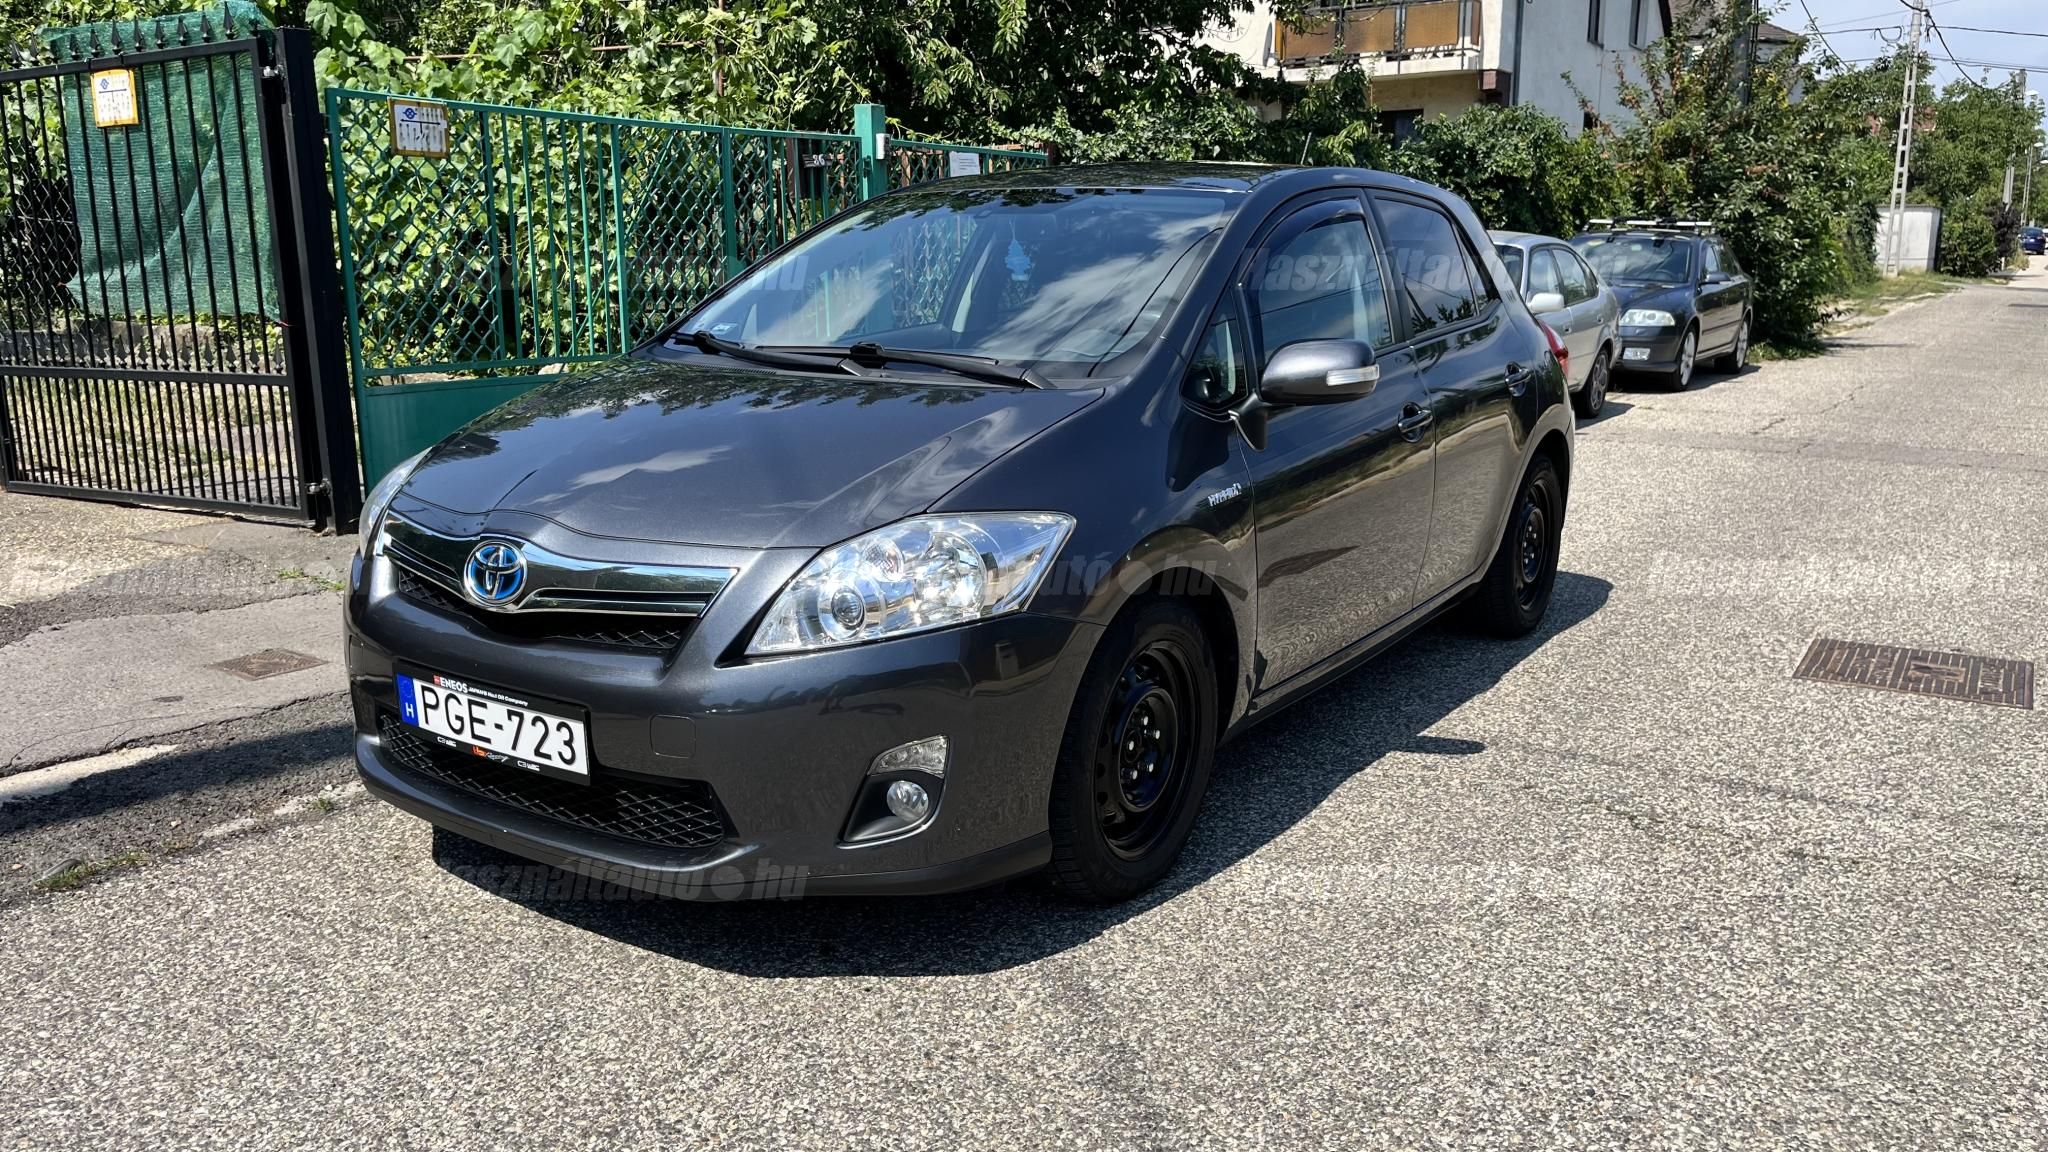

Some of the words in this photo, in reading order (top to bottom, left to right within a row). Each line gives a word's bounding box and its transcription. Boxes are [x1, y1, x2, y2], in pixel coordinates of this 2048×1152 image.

[440, 677, 468, 693] ENEOS
[405, 702, 415, 719] H
[421, 685, 576, 765] PGE-723
